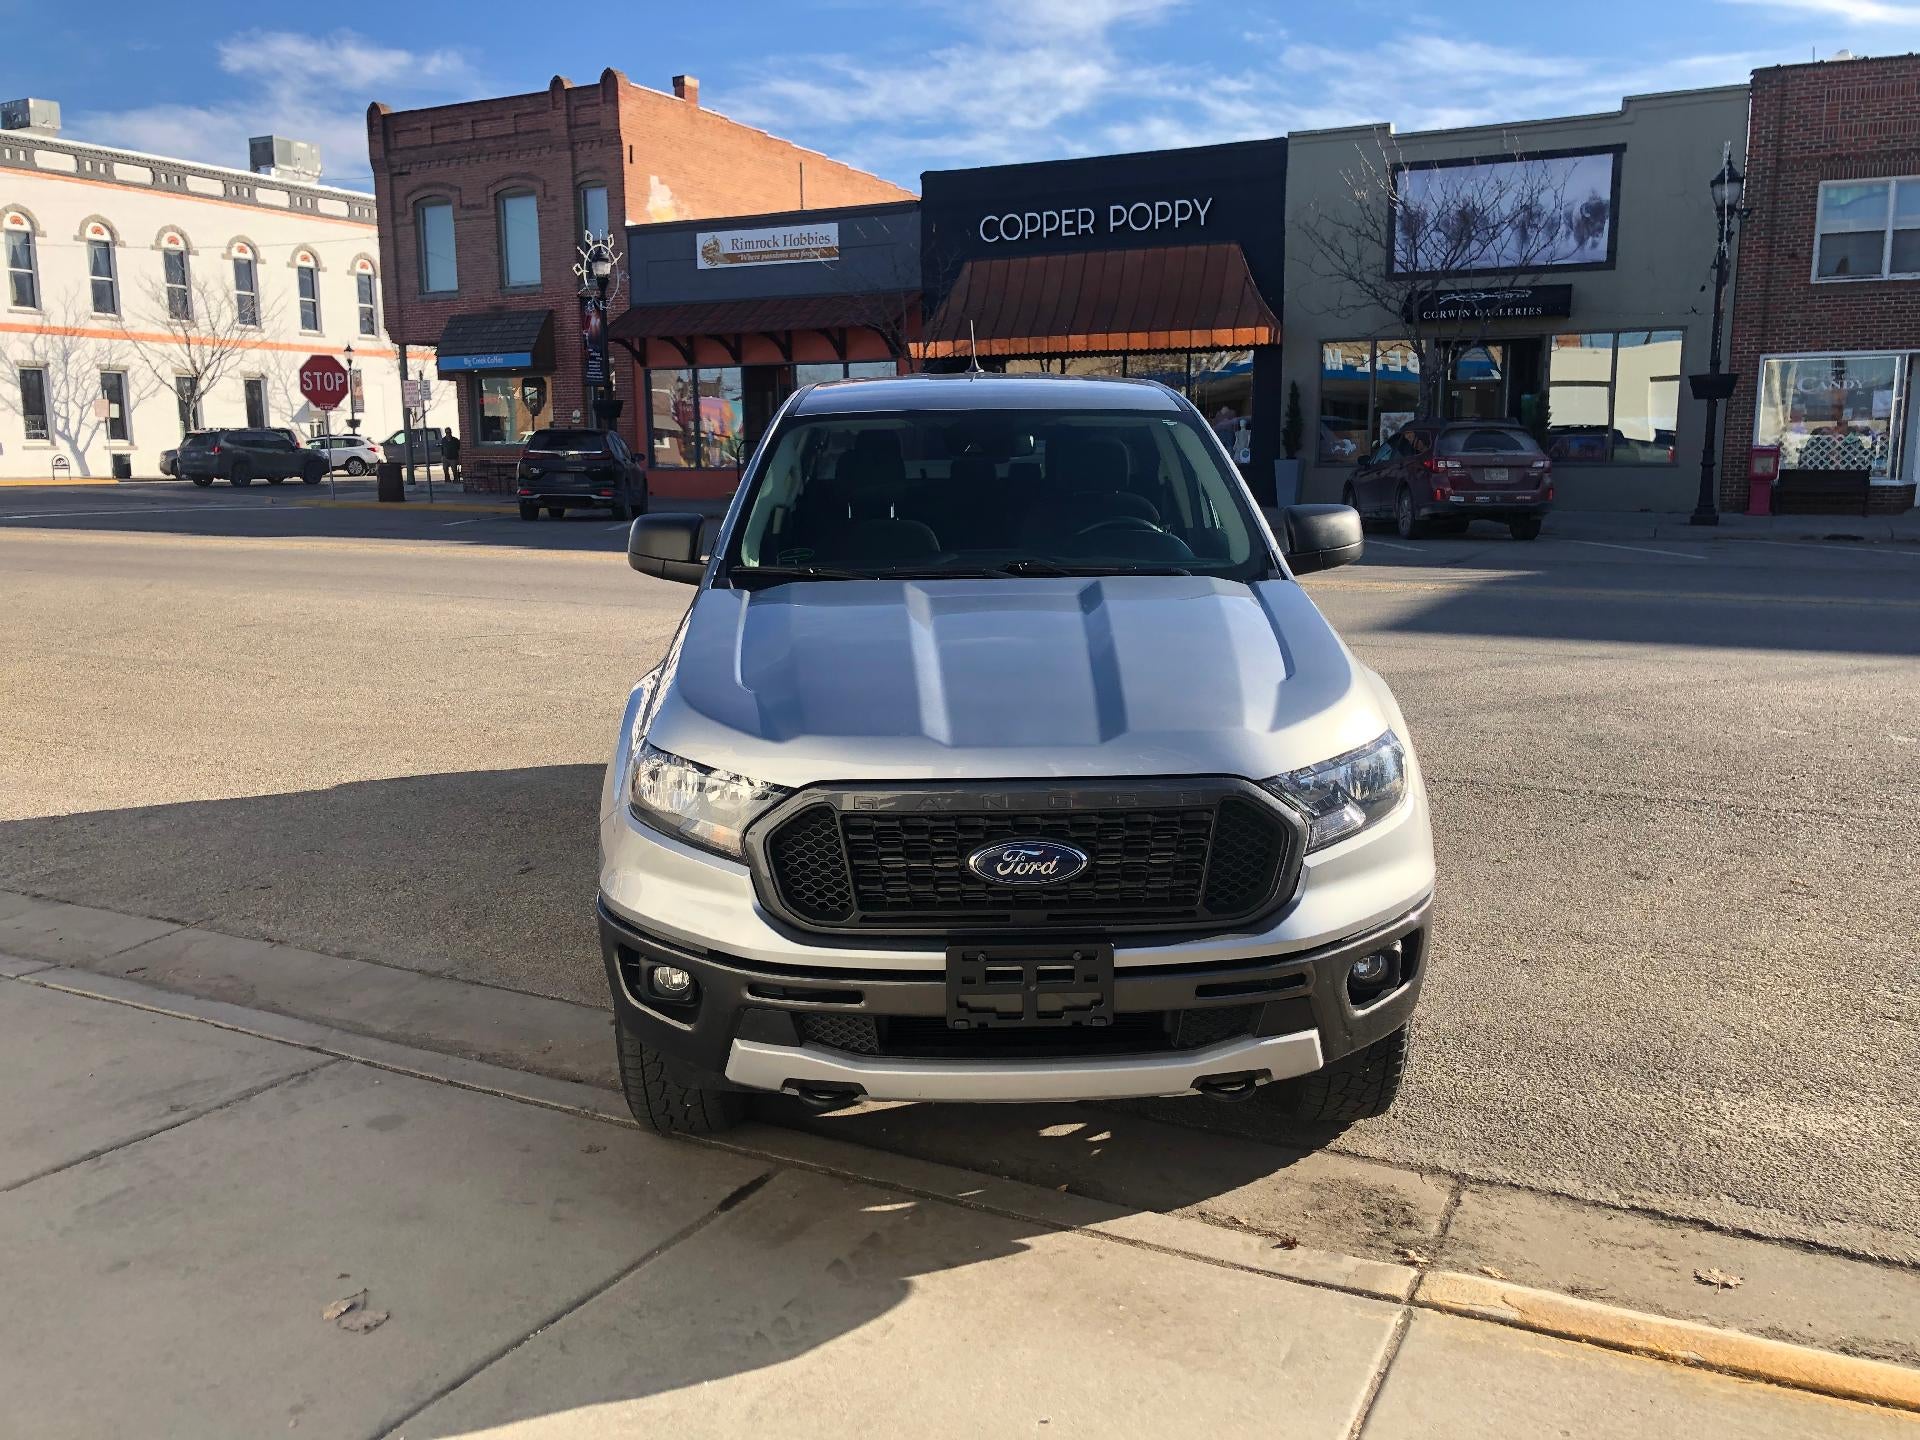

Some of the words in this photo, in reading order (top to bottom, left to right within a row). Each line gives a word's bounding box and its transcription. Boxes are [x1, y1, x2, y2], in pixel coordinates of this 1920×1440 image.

[979, 207, 1095, 242] COPPER
[1109, 197, 1213, 233] POPPY
[731, 235, 780, 250] Rimrock
[782, 232, 831, 248] Hobbies
[1423, 308, 1471, 319] CORWIN
[302, 371, 345, 391] STOP
[1797, 377, 1863, 394] CANDY
[996, 849, 1059, 875] Ford
